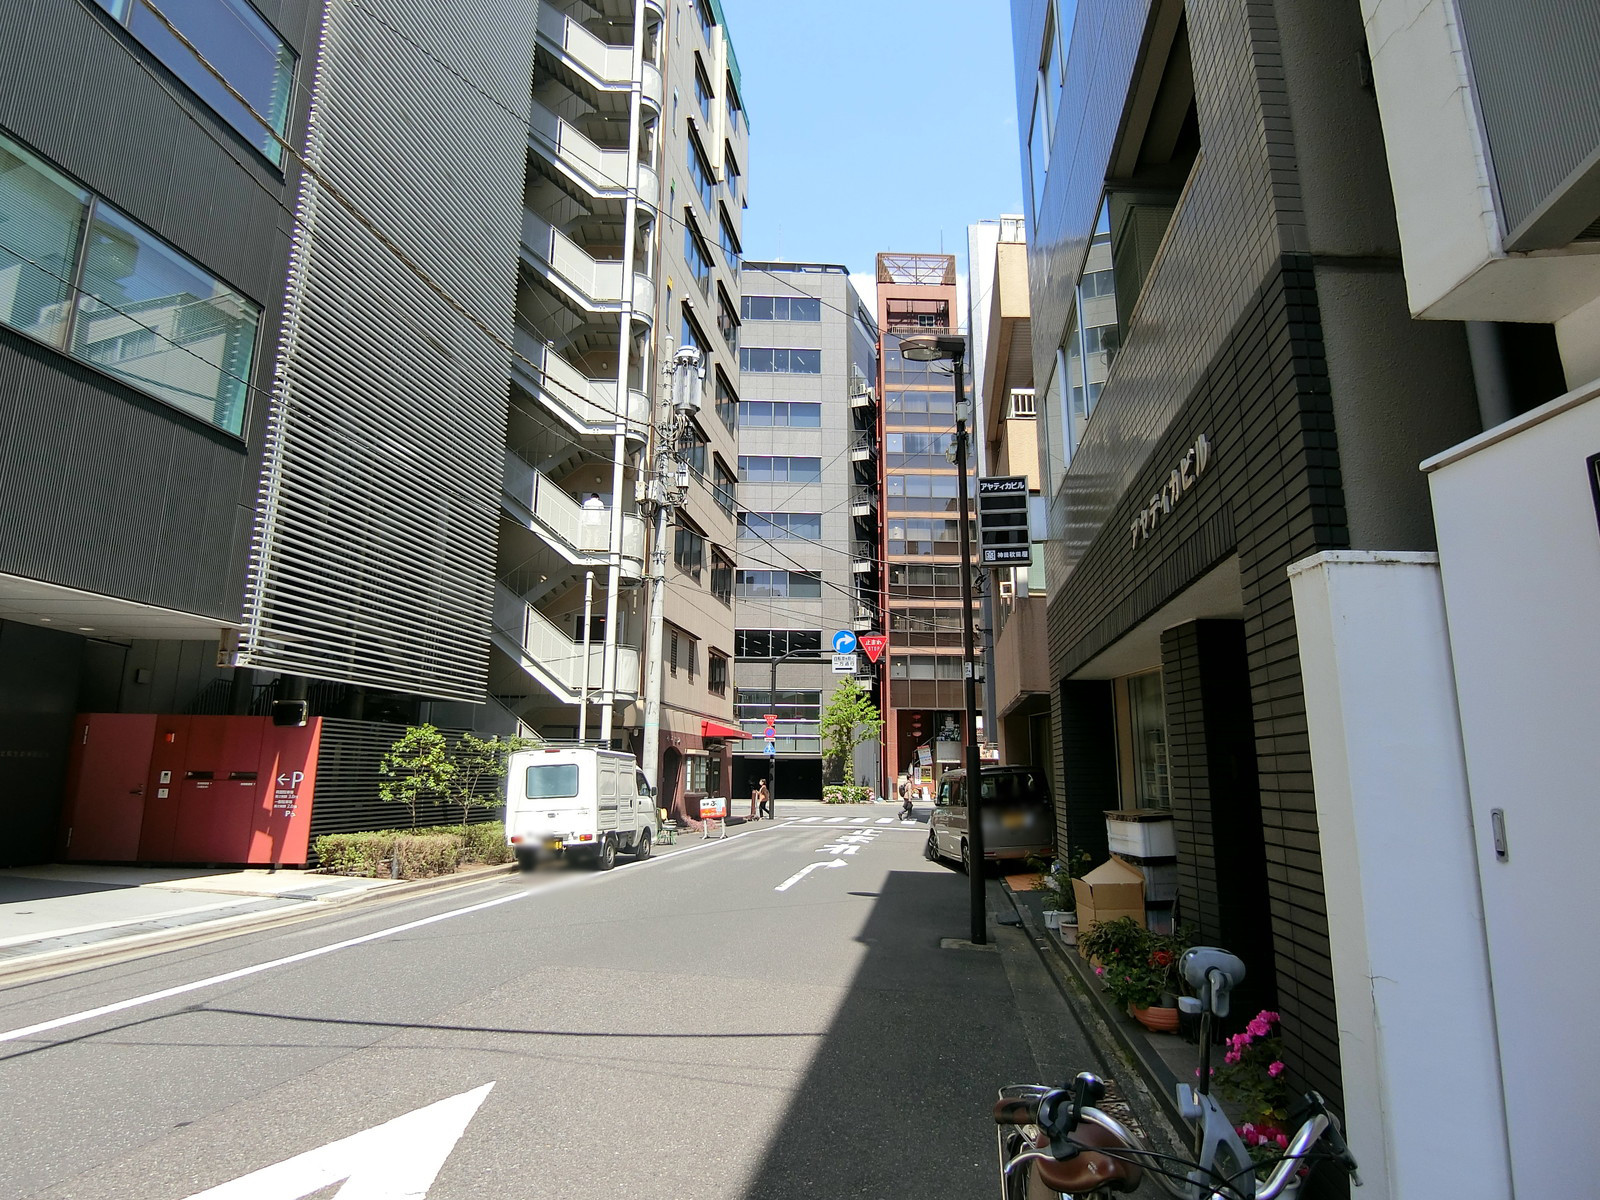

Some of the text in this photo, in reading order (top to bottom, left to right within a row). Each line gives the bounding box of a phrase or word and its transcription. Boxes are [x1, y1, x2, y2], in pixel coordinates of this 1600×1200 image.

[980, 481, 1025, 491] アヤティカビル
[1130, 433, 1211, 550] アヤティカビル
[564, 613, 571, 622] 2
[291, 771, 305, 789] P
